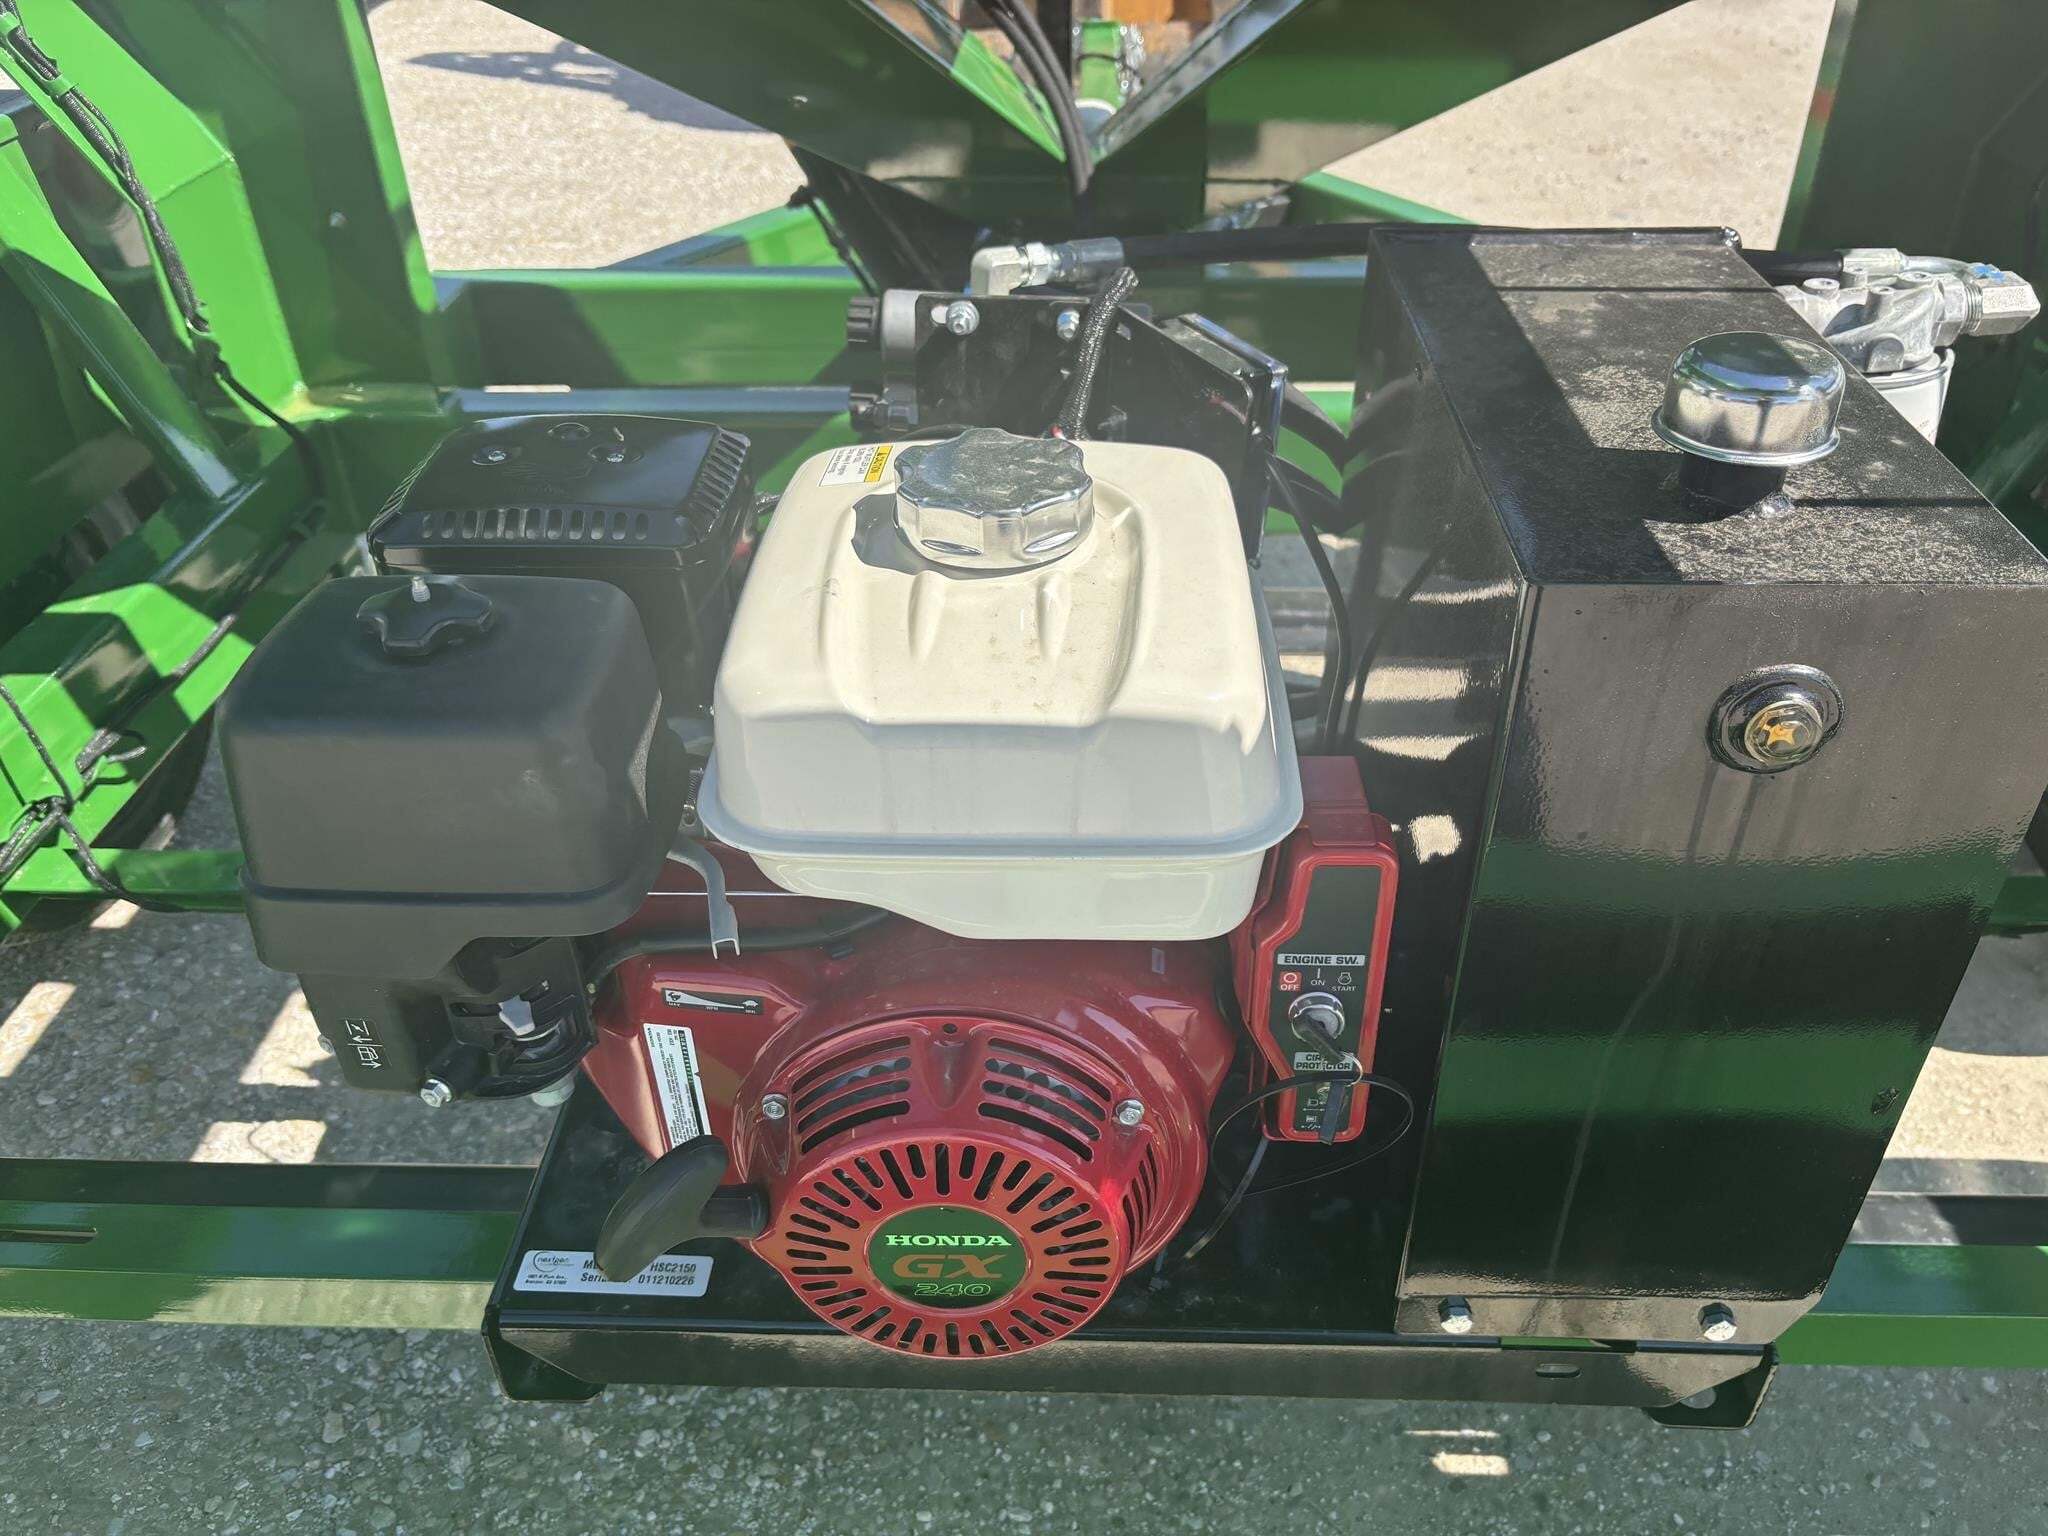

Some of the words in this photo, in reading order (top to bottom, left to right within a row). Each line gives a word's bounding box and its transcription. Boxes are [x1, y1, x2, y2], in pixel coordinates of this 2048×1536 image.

[1284, 955, 1332, 965] ENGINE
[1336, 955, 1359, 965] SW.
[885, 1235, 1012, 1246] HONDA
[650, 1263, 697, 1273] HSC2150
[892, 1254, 1007, 1279] GX
[914, 1283, 991, 1297] 240
